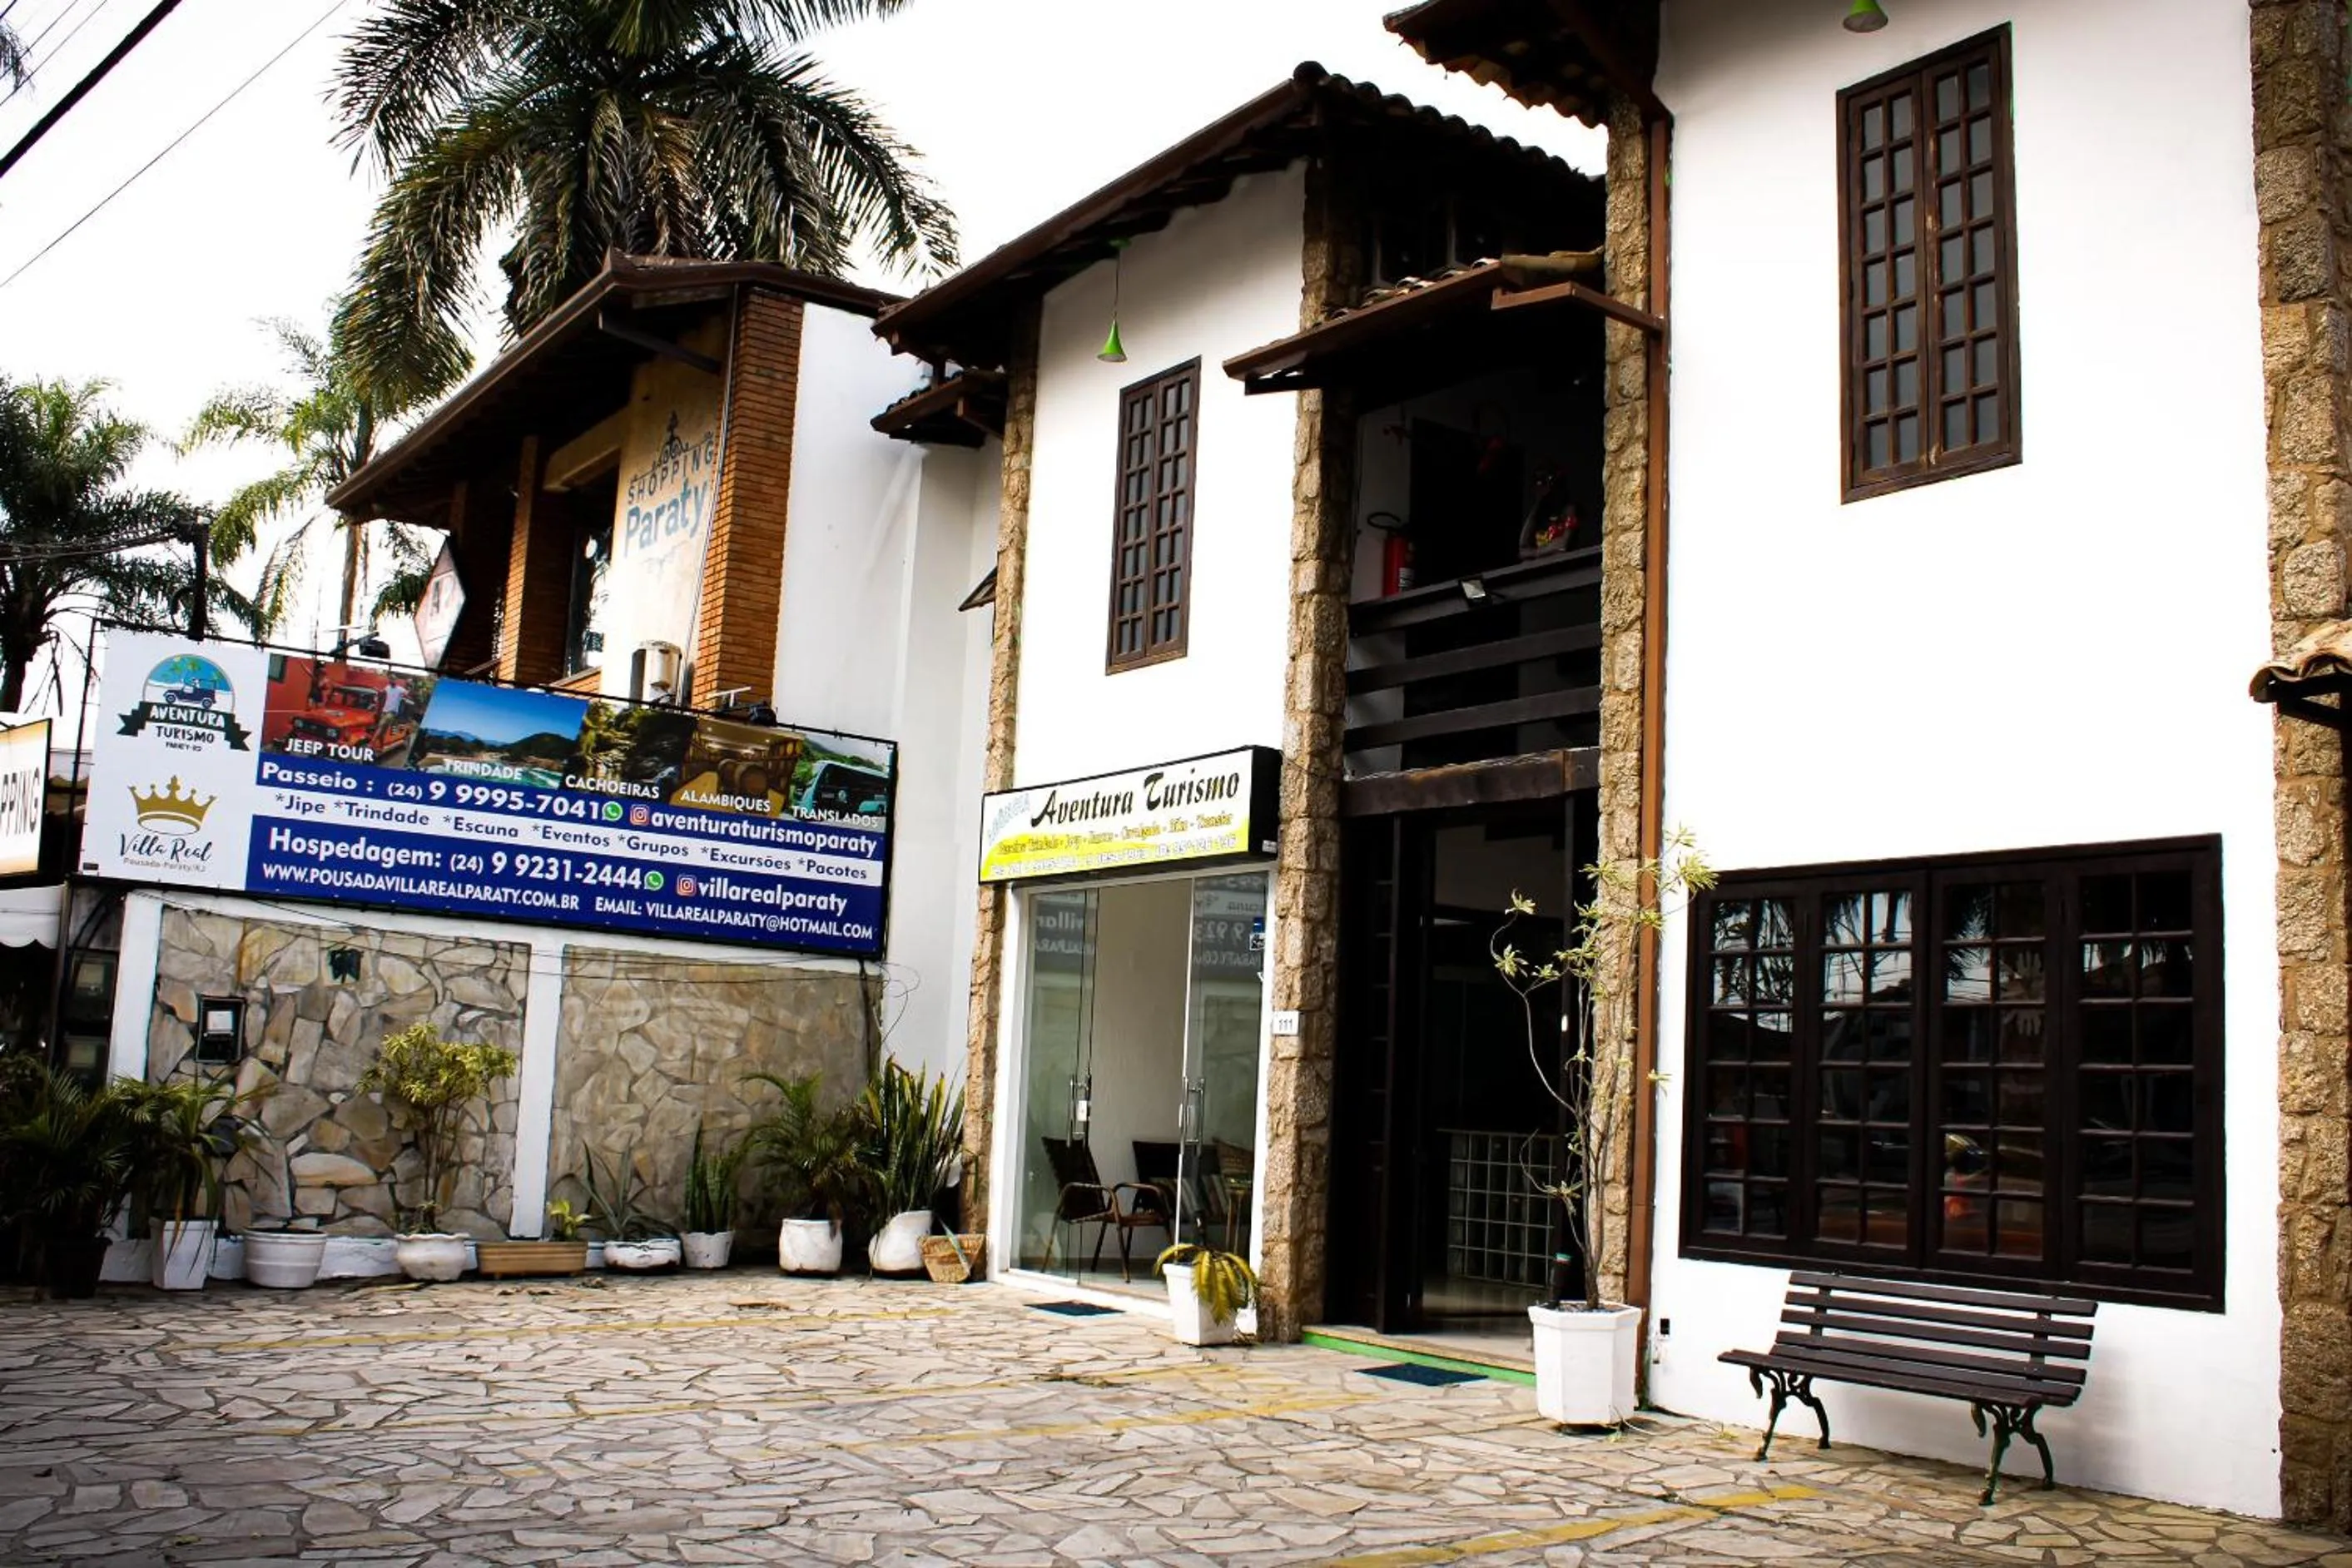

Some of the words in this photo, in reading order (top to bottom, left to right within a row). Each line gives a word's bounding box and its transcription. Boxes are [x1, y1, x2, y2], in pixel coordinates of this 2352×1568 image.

[628, 440, 714, 504] SHOPPING
[625, 478, 707, 558] Paraty
[149, 706, 225, 728] AVENTURA
[156, 725, 215, 744] TURISMO
[285, 737, 323, 755] JEEP
[326, 743, 374, 762] TOUR
[444, 758, 523, 780] TRINDADE
[262, 762, 357, 791] Passeio
[387, 782, 423, 800] (24)
[429, 781, 447, 801] 9
[455, 784, 599, 820] 9995-7041
[565, 774, 660, 800] CACHOEIRAS
[680, 790, 772, 813] ALAMBIQUES
[1030, 790, 1134, 827] Aventura
[1144, 767, 1240, 811] Turismo
[791, 805, 879, 828] TRANSLADOS
[120, 833, 166, 857] Villa
[170, 837, 213, 863] Real
[652, 811, 876, 859] aventuraturismoparaty
[269, 826, 441, 868] Hospedagem:
[450, 854, 484, 875] (24)
[492, 851, 508, 874] 9
[514, 854, 643, 889] 9231-2444
[262, 862, 580, 911] WWW.POUSADAVILLAREALPARATY.COM.BR
[595, 896, 643, 915] EMAIL:
[646, 901, 873, 940] VILLAREALPARATY@HOTMAIL.COM
[697, 876, 848, 917] villarealparaty
[1278, 1018, 1293, 1032] 111
